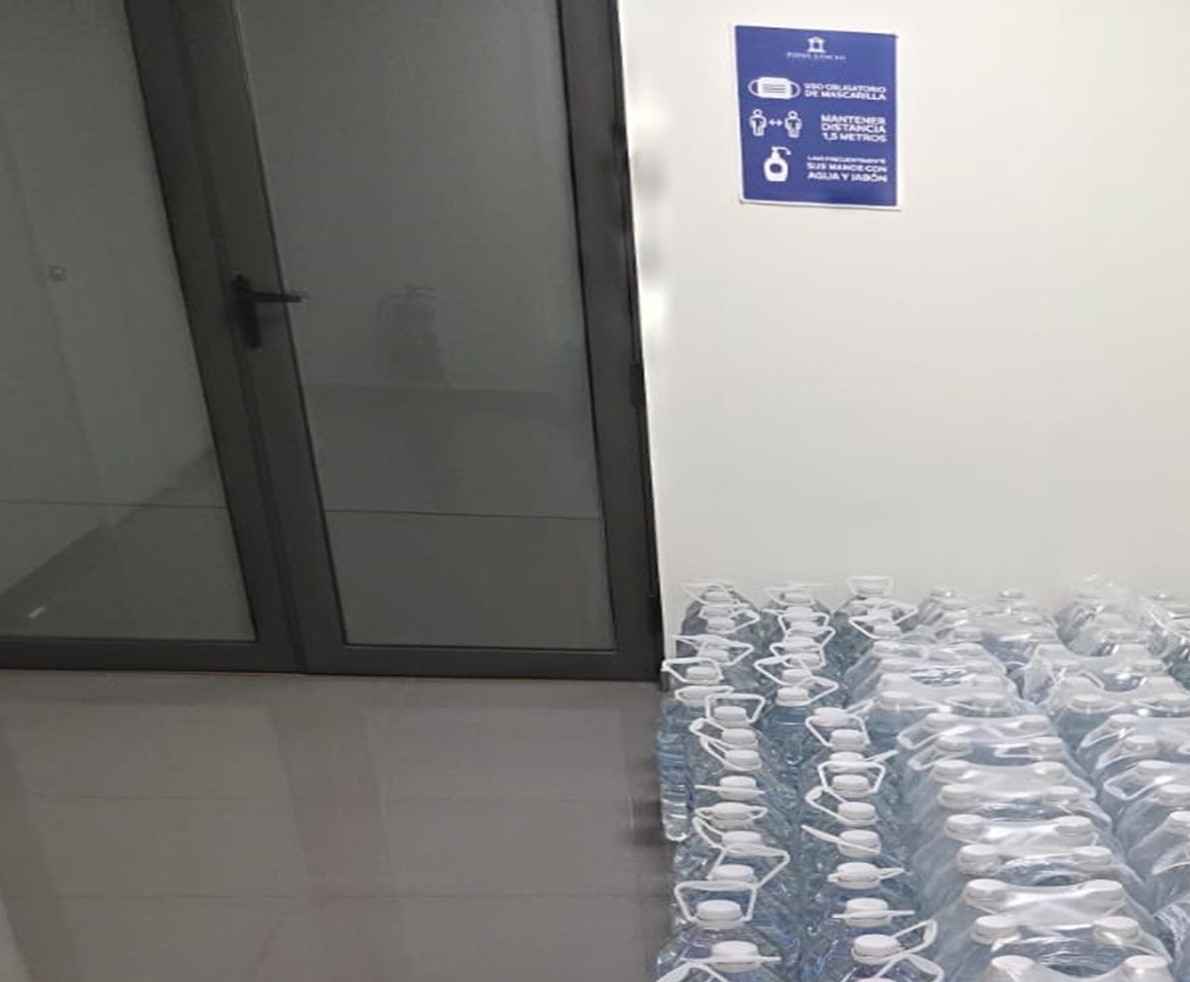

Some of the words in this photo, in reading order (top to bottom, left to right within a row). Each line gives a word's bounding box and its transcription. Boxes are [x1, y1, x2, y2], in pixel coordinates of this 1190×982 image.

[821, 91, 886, 100] MASCARILLA
[821, 114, 886, 125] MANTENER
[821, 123, 887, 134] DISTANCIA
[839, 133, 887, 142] METROS
[807, 171, 840, 179] AGUA
[840, 172, 849, 181] Y
[851, 172, 888, 182] JABÓN
